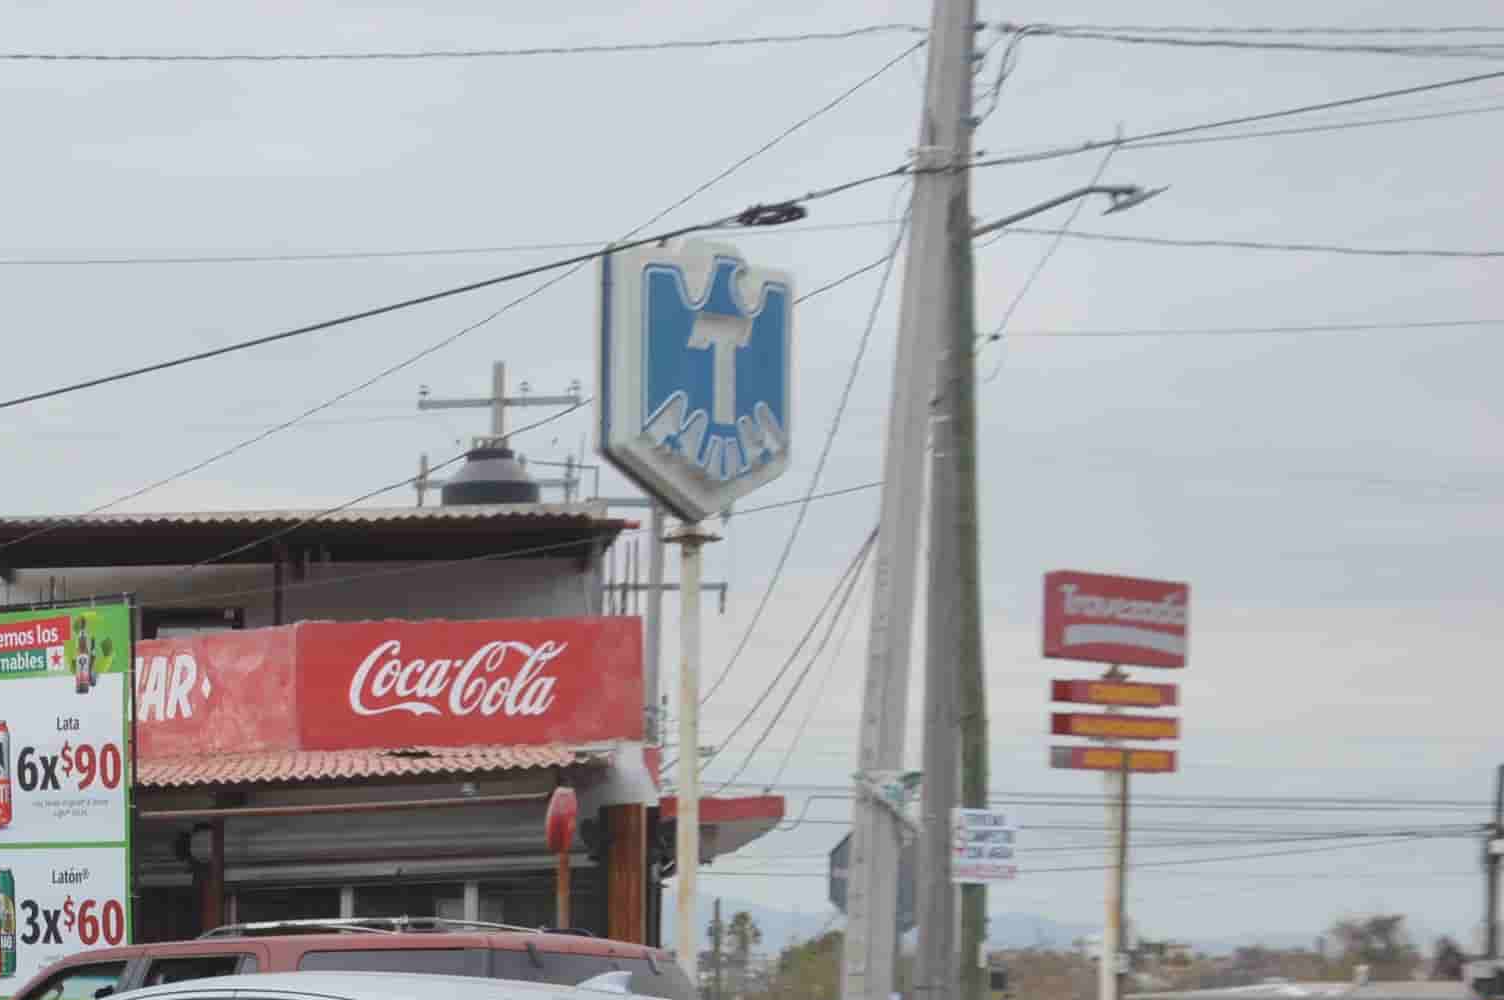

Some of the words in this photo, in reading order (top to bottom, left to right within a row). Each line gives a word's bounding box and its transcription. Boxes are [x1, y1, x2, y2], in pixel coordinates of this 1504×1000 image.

[36, 624, 59, 643] los
[349, 640, 569, 717] Coca-Cola
[56, 716, 80, 731] Lata
